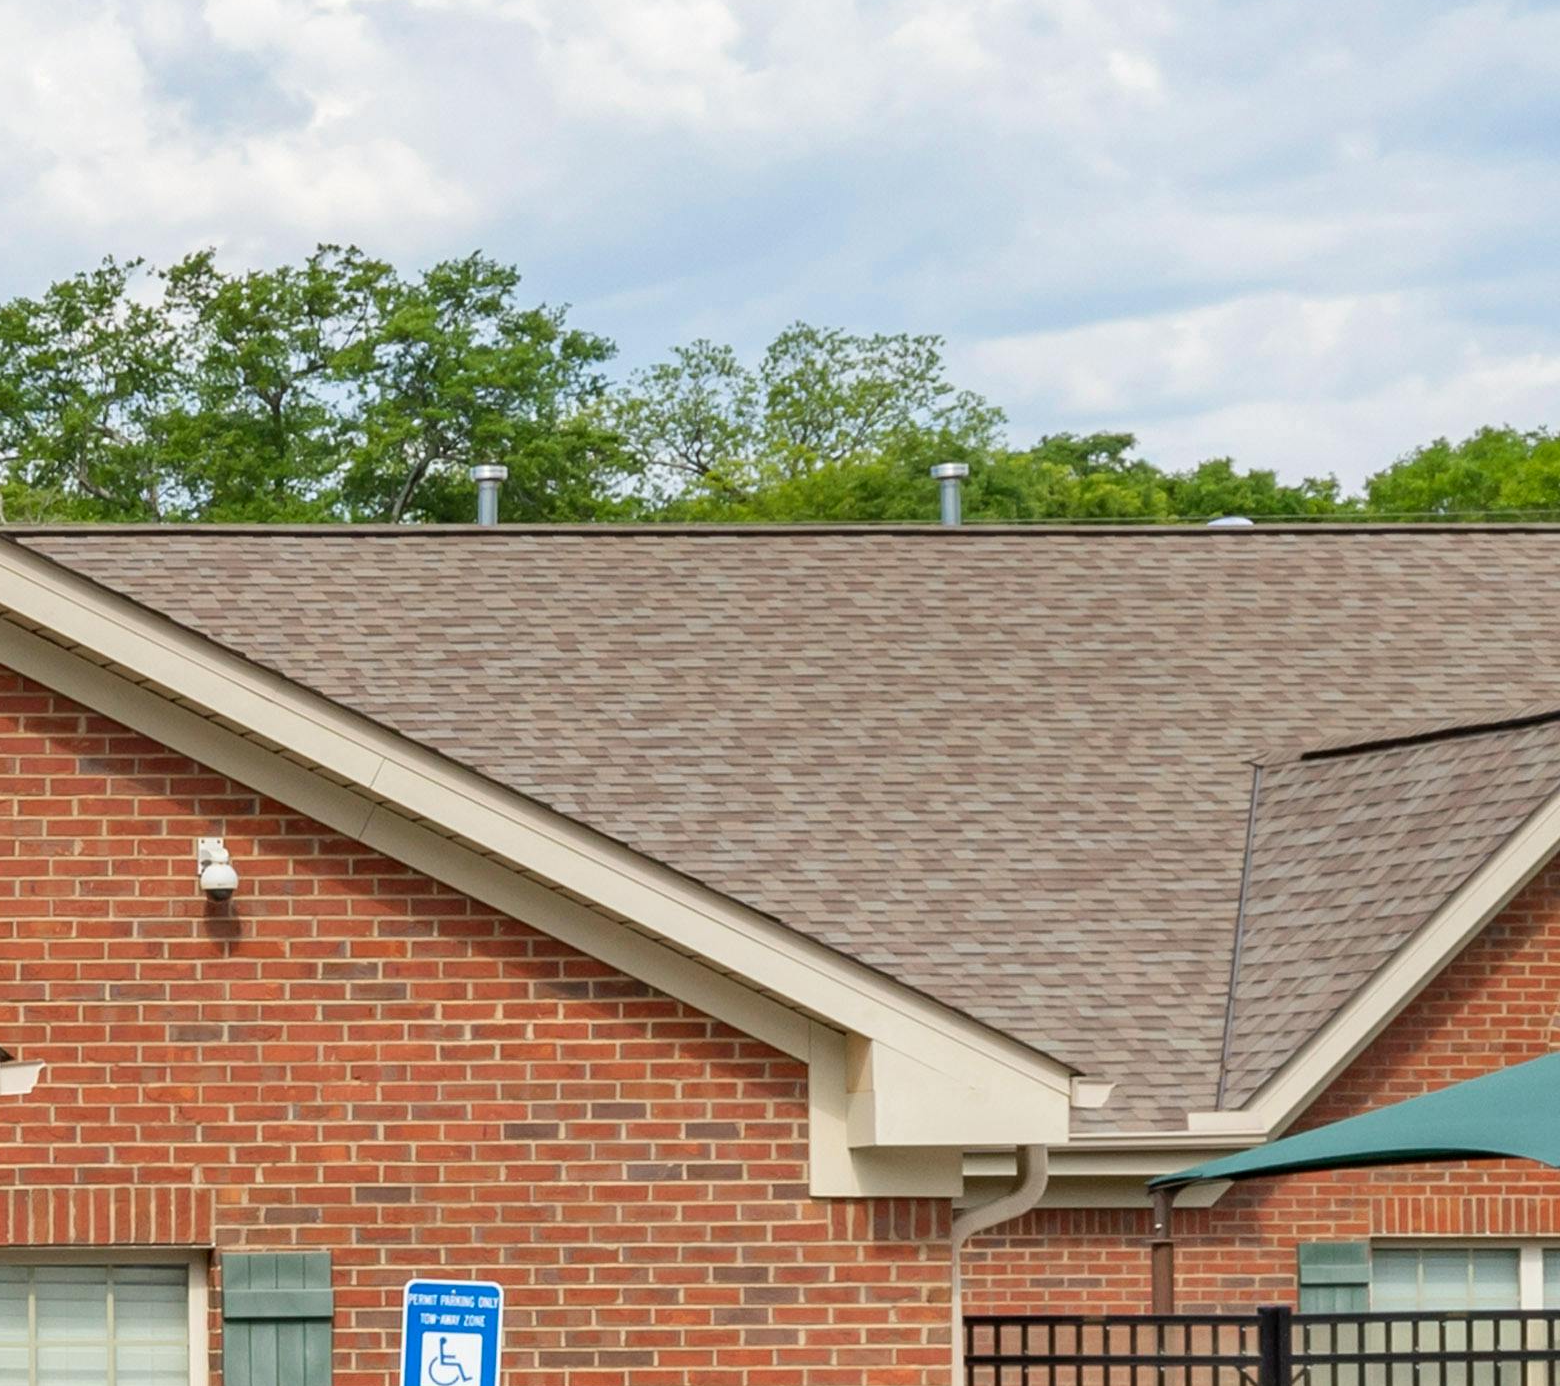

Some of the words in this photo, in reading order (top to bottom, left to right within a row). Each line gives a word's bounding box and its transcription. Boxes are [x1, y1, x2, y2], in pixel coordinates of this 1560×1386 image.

[407, 1293, 438, 1306] PERMIT
[440, 1294, 475, 1308] PARKING
[478, 1296, 499, 1309] ONLY
[420, 1313, 460, 1325] TOW-AWAY
[463, 1314, 486, 1327] ZONE
